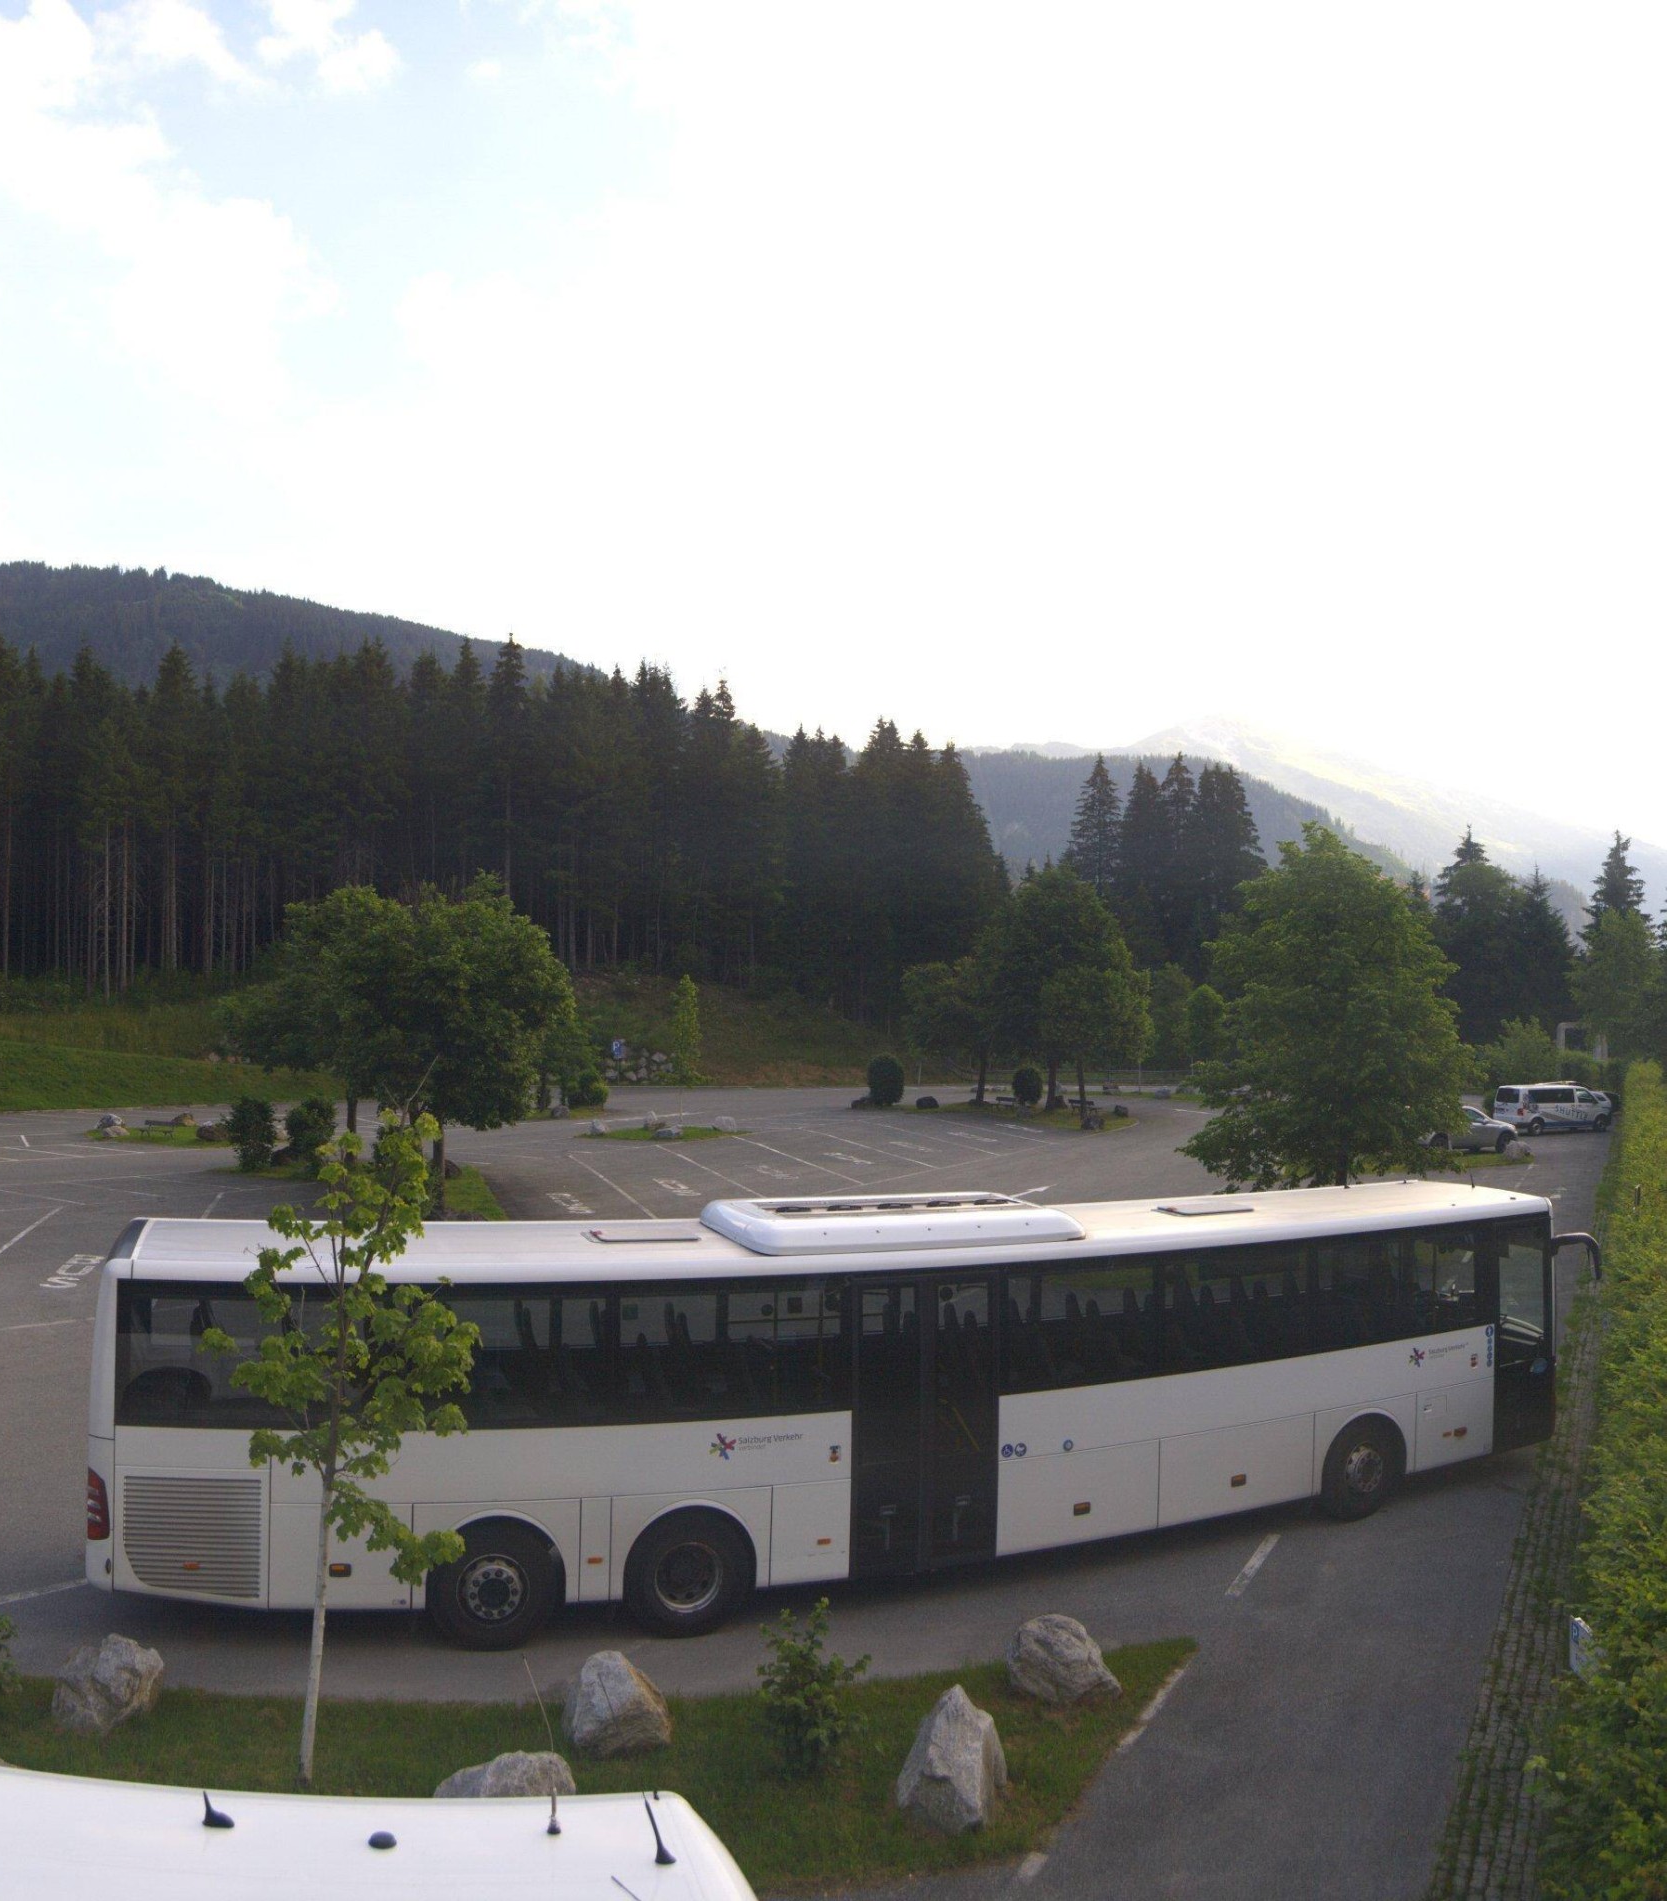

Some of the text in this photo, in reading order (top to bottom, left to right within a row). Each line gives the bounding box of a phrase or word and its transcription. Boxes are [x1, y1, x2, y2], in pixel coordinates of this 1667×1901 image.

[613, 1041, 620, 1051] P
[1555, 1104, 1588, 1120] SHUTTLE
[39, 1254, 106, 1289] BUS
[738, 1432, 803, 1445] Salzburg Verkehr
